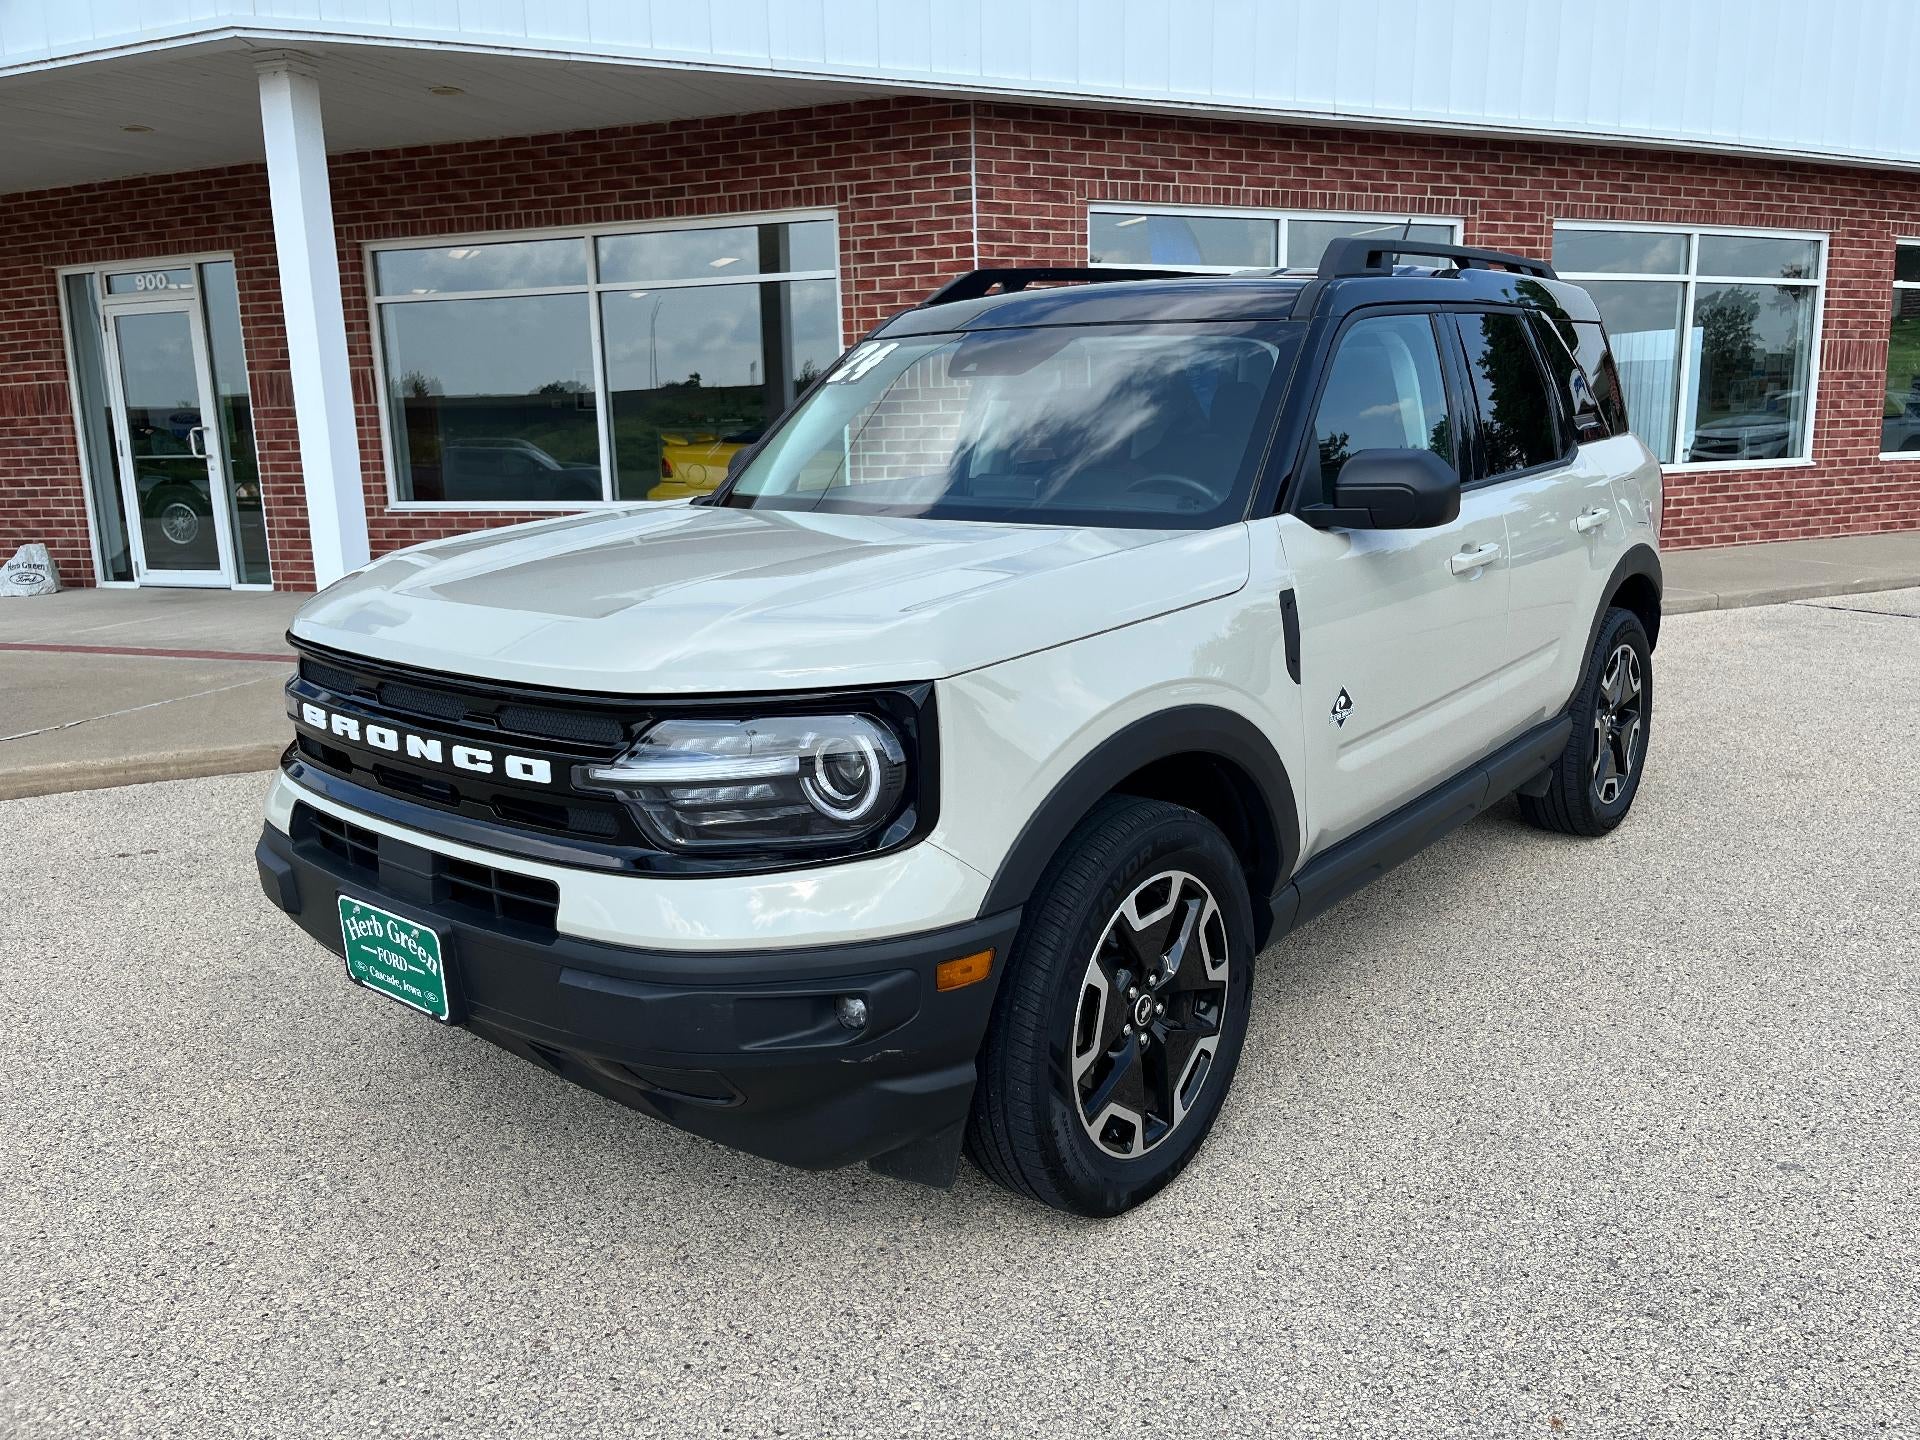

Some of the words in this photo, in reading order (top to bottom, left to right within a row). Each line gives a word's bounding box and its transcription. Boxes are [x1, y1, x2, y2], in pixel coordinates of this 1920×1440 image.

[135, 273, 167, 291] 900
[16, 574, 37, 584] Ford
[302, 702, 552, 784] BRONCO
[345, 915, 384, 940] Herb
[386, 920, 438, 977] Green
[377, 946, 408, 972] FORD
[369, 966, 402, 990] Cascade,
[403, 980, 422, 998] Iowa
